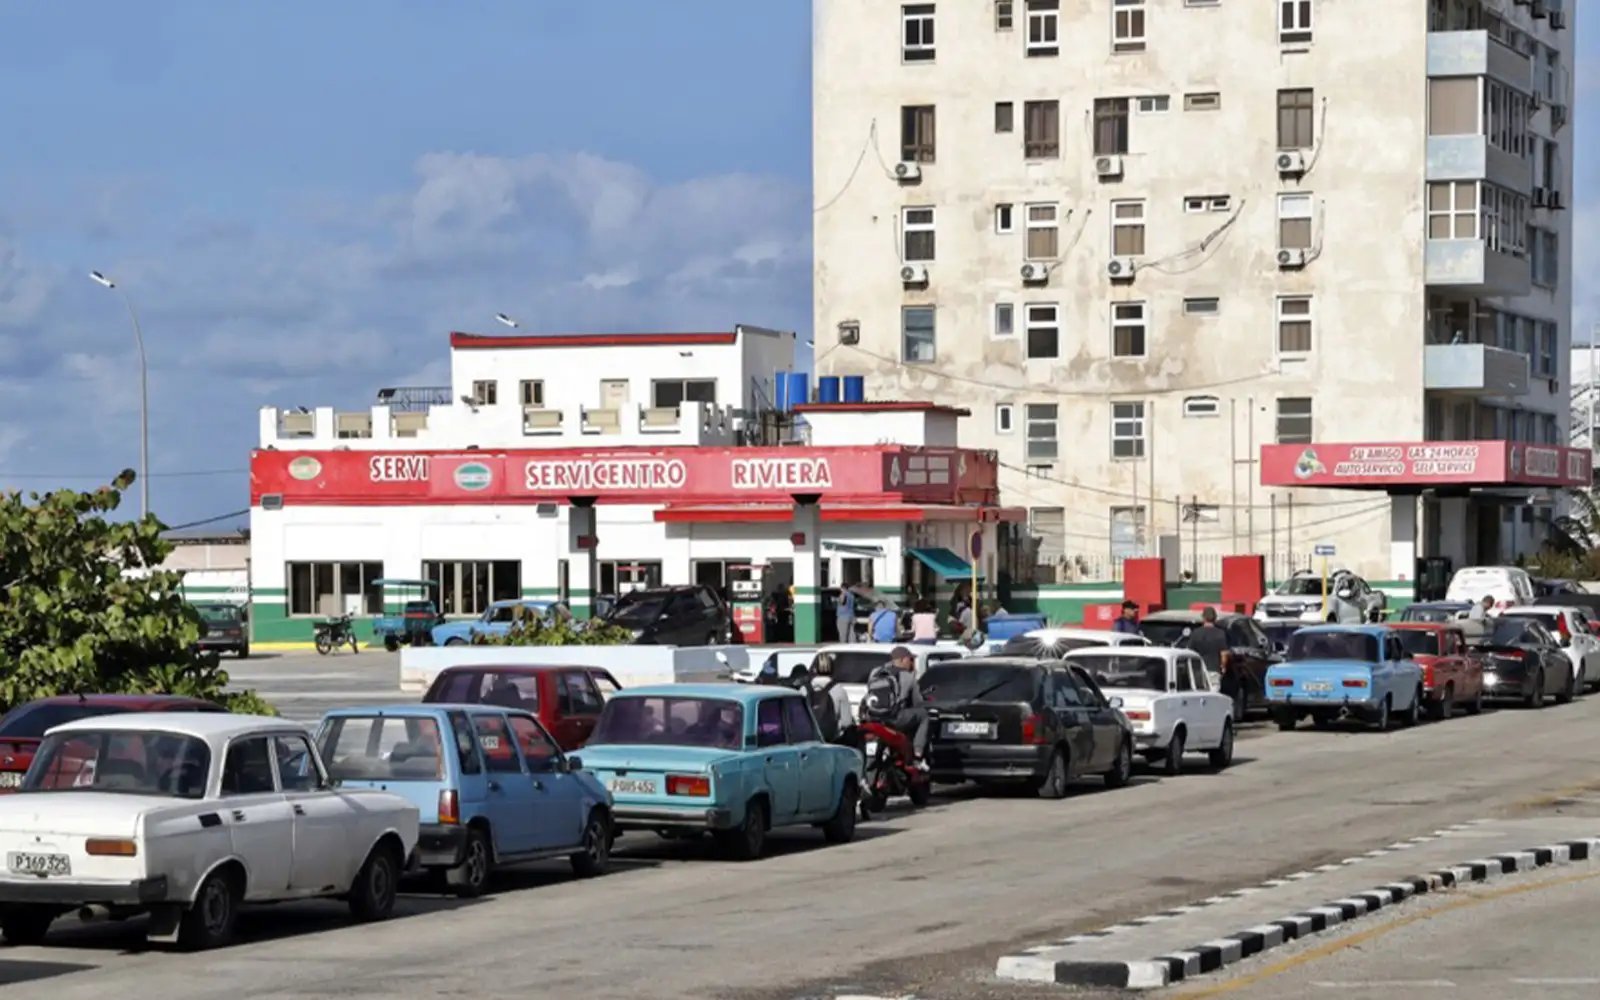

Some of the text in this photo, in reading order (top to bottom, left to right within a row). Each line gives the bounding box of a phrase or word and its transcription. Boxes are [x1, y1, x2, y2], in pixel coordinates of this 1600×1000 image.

[1366, 447, 1402, 459] AMIGO
[1408, 447, 1426, 459] LAS
[1443, 446, 1478, 458] HORAS
[371, 456, 428, 481] SERVI
[526, 460, 831, 487] SERVICENTRO RIVIERA
